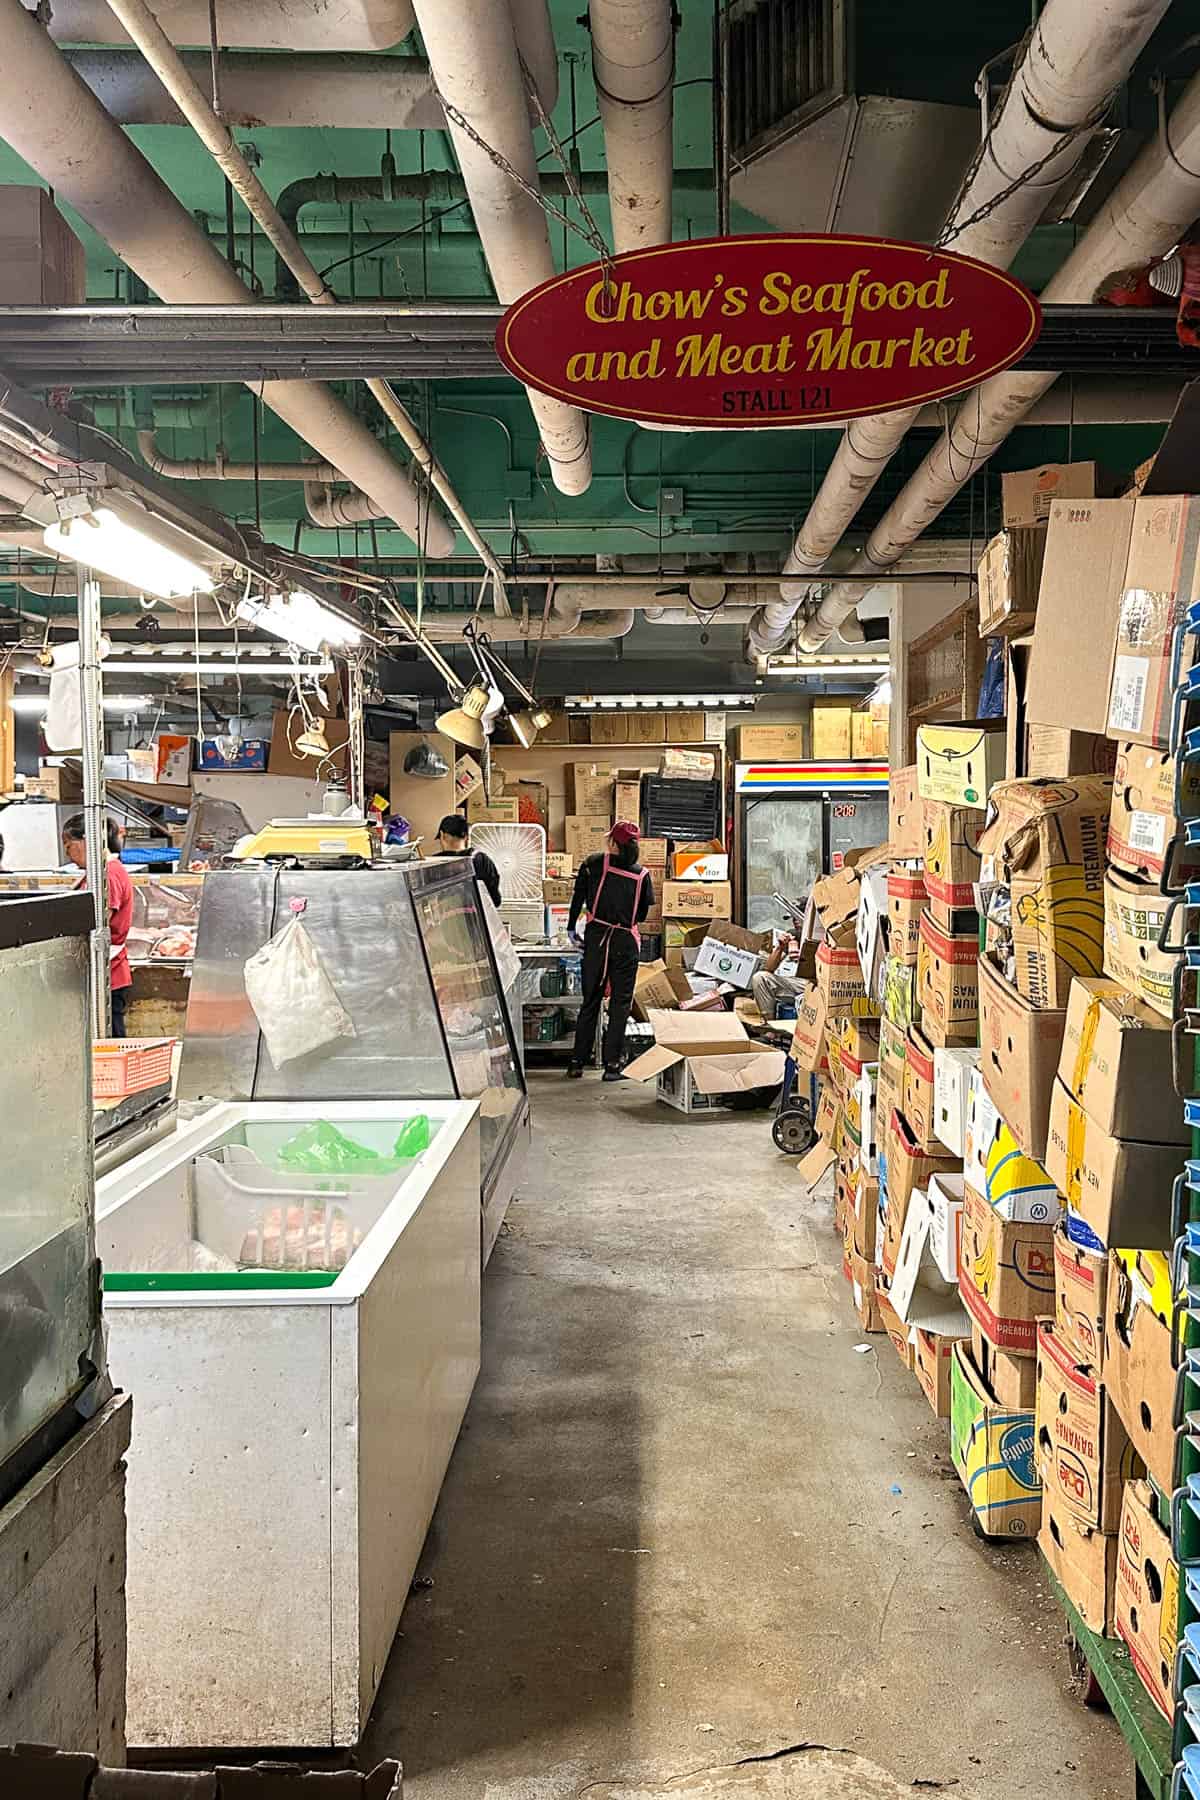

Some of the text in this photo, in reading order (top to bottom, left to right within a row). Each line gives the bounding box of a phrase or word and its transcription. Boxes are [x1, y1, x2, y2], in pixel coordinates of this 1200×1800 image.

[585, 268, 954, 325] Chow's Seafood
[565, 327, 976, 383] and Meat Market
[721, 387, 832, 414] STALL 121
[1080, 815, 1101, 893] PREMIUM
[996, 1322, 1034, 1338] PREMIU
[1055, 1417, 1094, 1459] BANANAS
